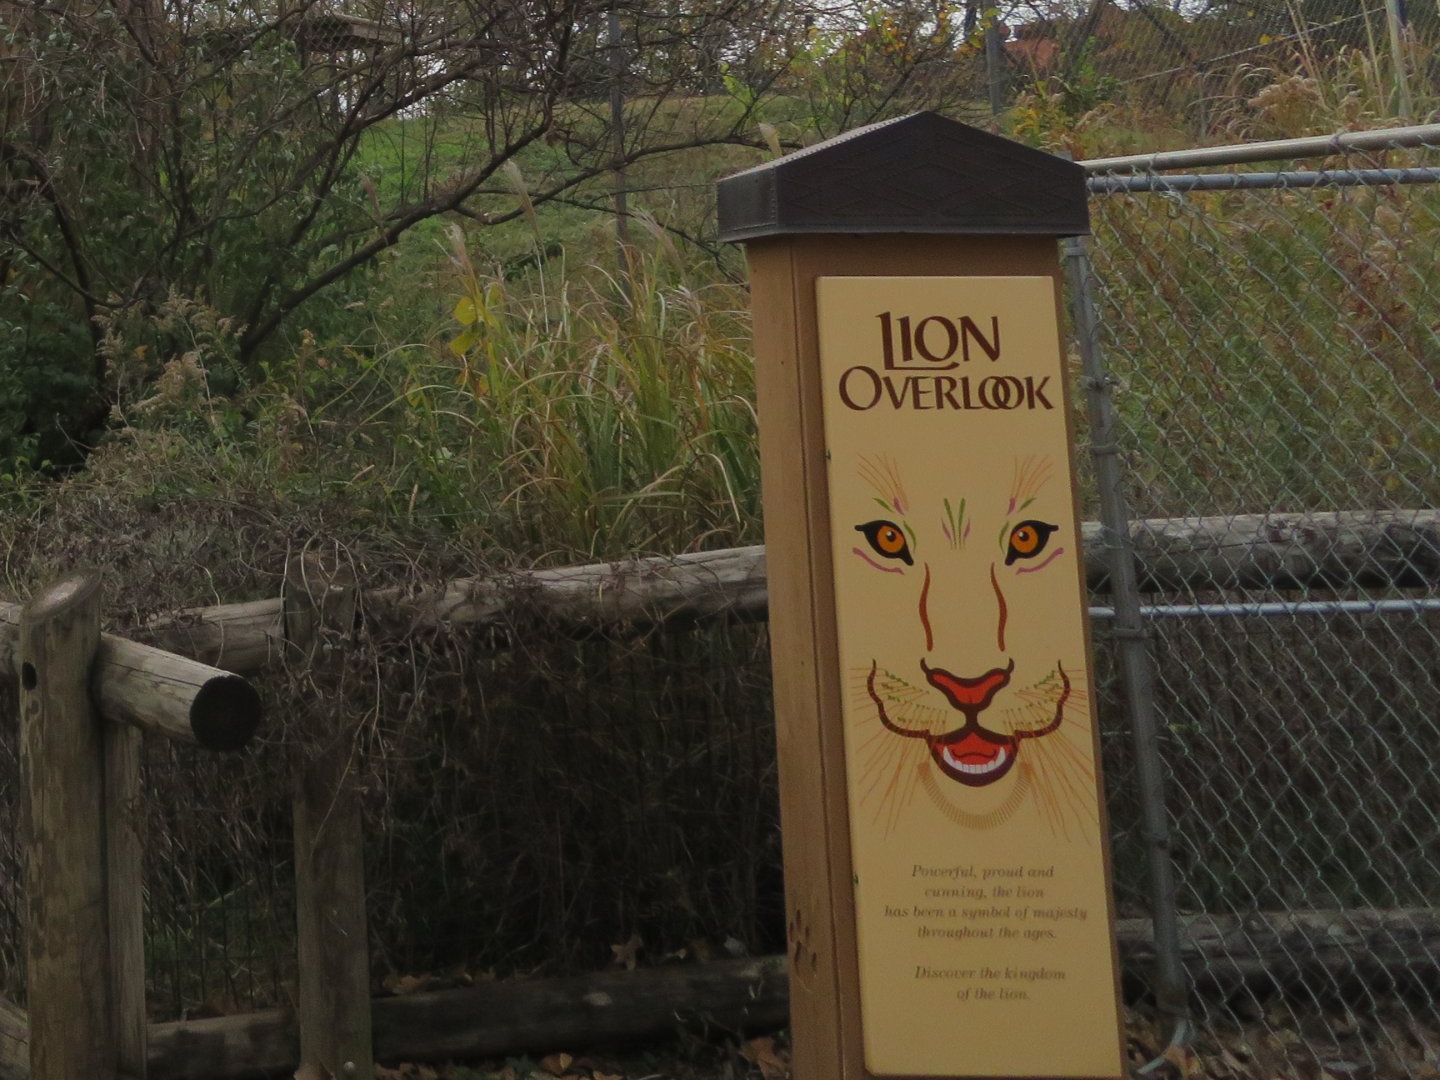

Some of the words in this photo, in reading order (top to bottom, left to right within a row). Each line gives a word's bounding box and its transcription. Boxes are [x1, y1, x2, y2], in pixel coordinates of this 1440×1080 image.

[875, 311, 1000, 370] LION
[911, 864, 977, 879] Powerful,
[982, 865, 1023, 880] proud
[1027, 865, 1054, 878] and
[924, 887, 987, 899] cunning,
[992, 886, 1012, 898] the
[1016, 886, 1044, 898] lion
[884, 906, 908, 917] has
[913, 906, 944, 917] been
[948, 908, 957, 917] a
[961, 906, 1010, 919] symbol
[1014, 906, 1029, 919] of
[1033, 907, 1087, 920] majesty
[917, 926, 993, 940] throughout
[998, 926, 1018, 938] the
[1023, 928, 1057, 941] ages.
[915, 966, 976, 980] Discover
[980, 967, 1001, 979] the
[1005, 967, 1066, 981] kingdom
[956, 988, 970, 1001] of
[975, 988, 994, 1000] the
